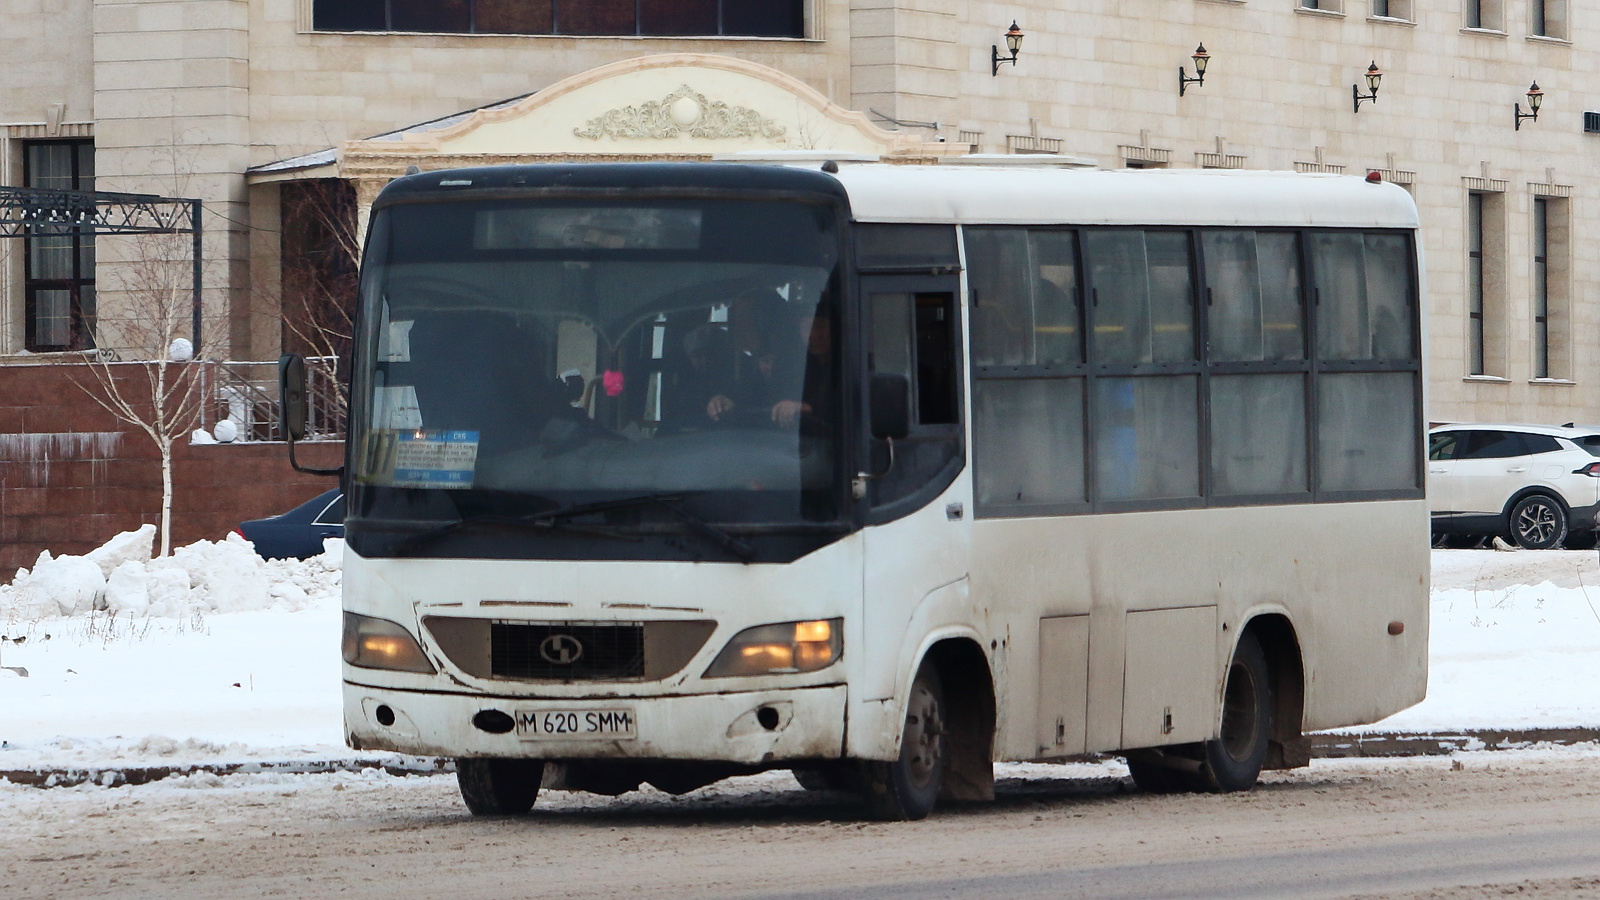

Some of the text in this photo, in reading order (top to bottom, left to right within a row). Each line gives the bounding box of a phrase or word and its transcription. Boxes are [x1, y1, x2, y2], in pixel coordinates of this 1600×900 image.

[522, 711, 629, 733] M 620 SMM
